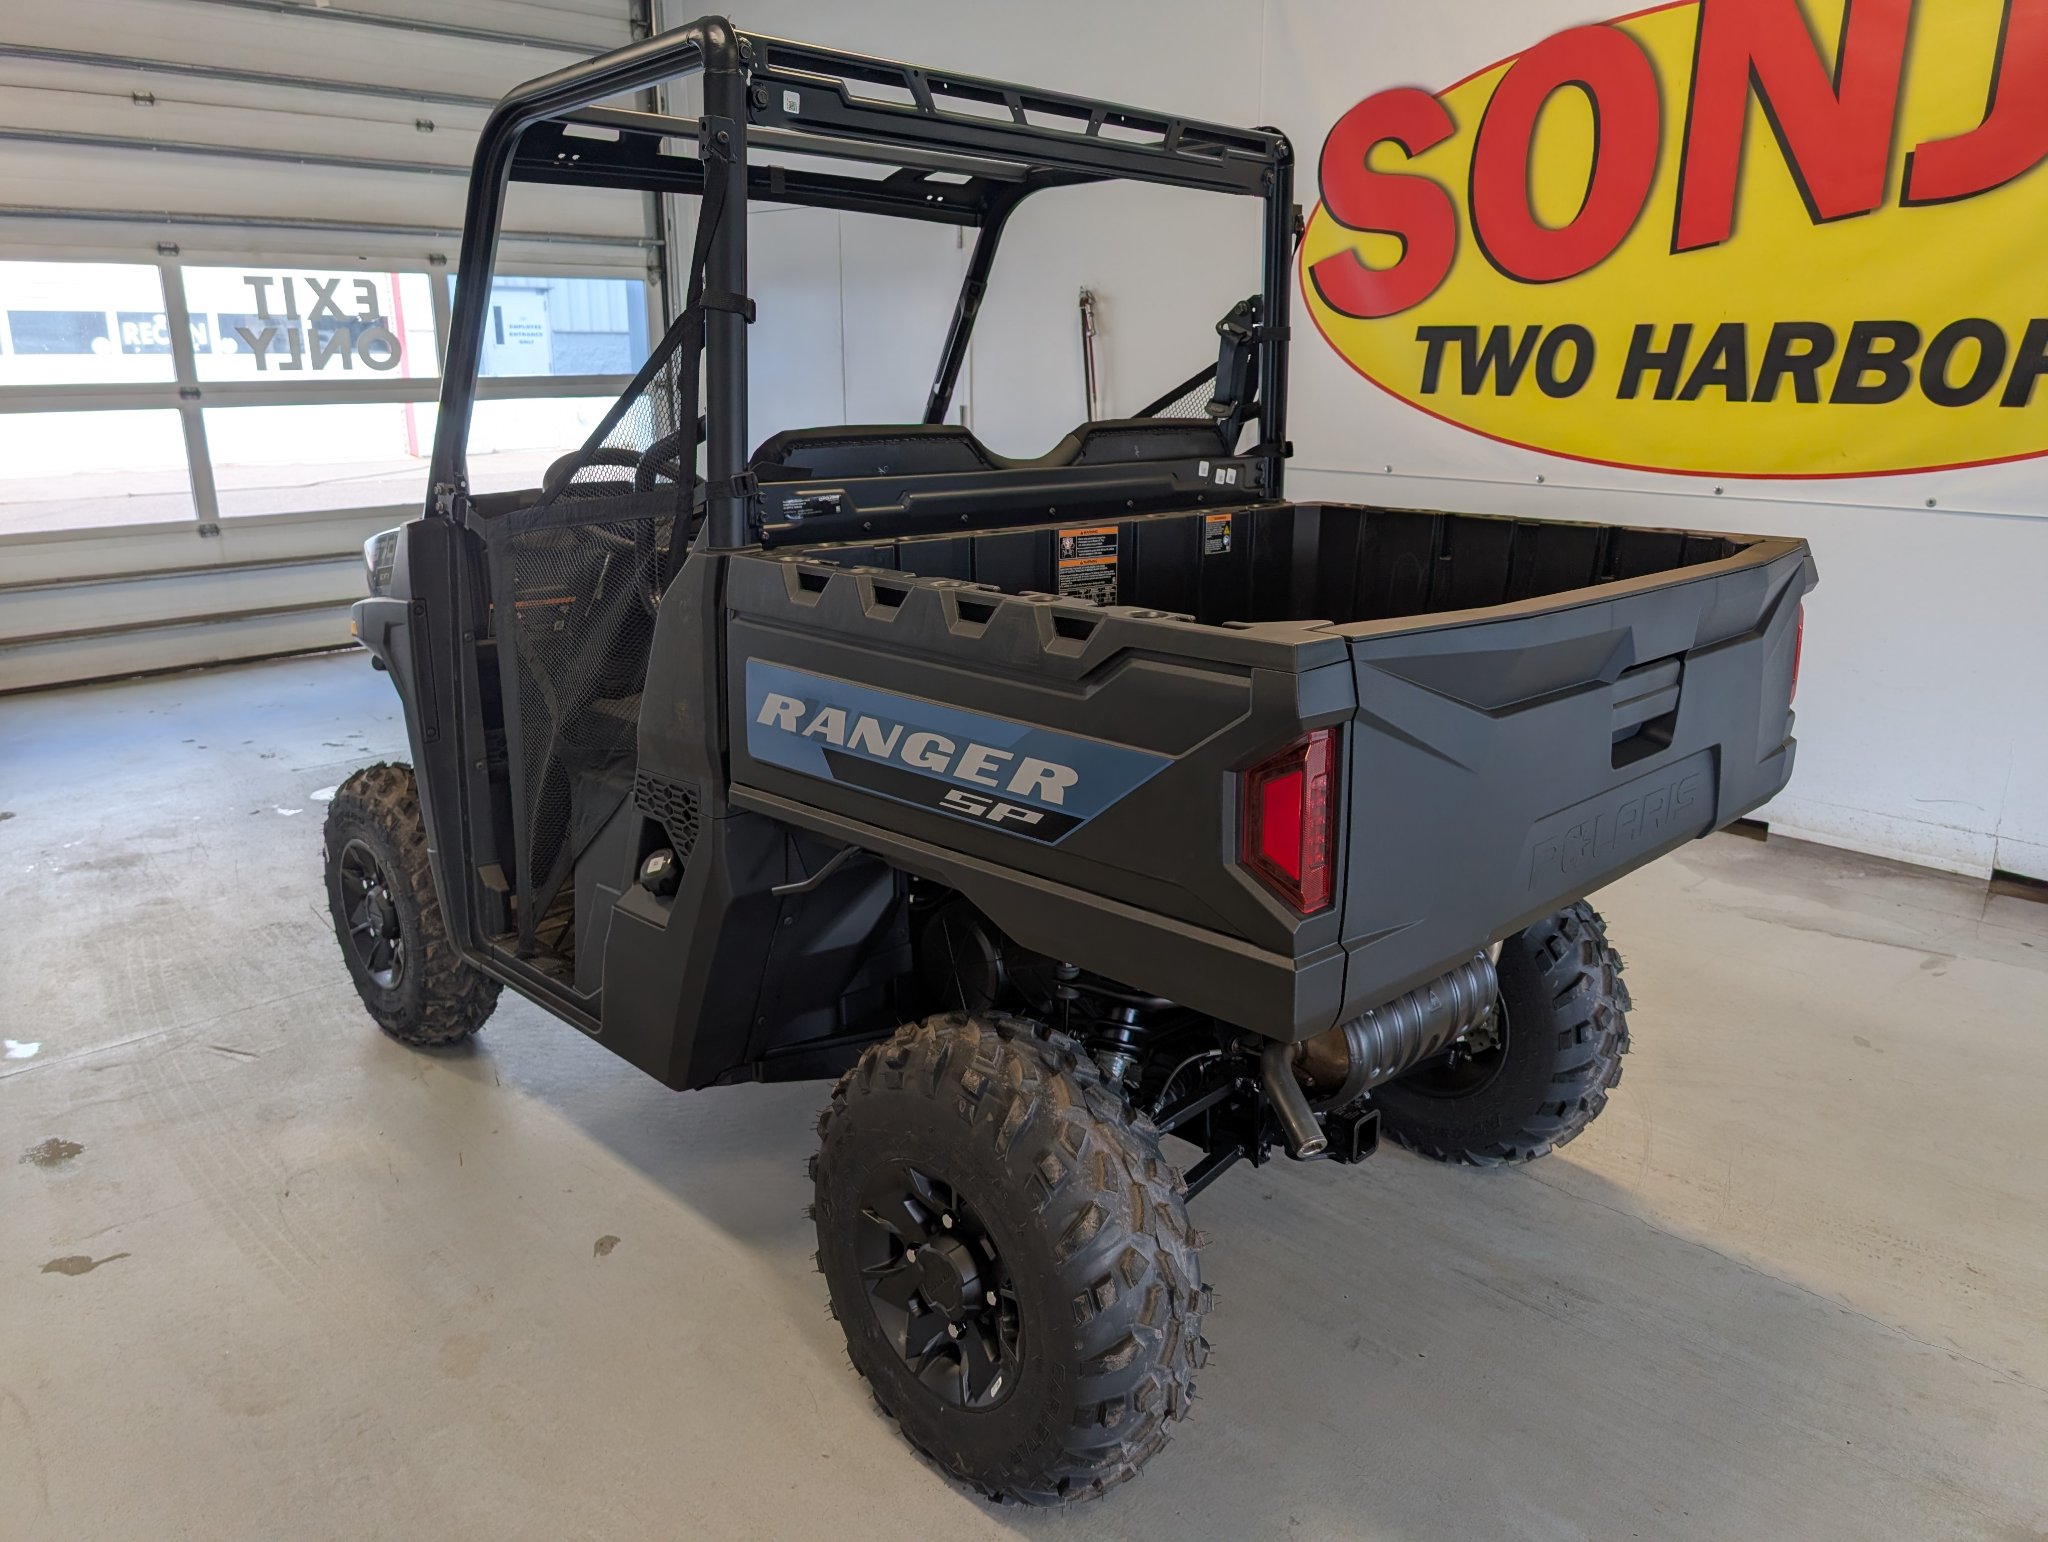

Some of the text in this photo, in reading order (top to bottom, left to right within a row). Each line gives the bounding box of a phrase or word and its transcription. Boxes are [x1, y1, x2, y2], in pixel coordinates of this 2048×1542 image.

[121, 311, 208, 348] RECN
[1415, 324, 1595, 399] TWO
[757, 692, 1079, 805] RANGER
[939, 789, 1045, 825] SP
[1528, 773, 1700, 892] POLARIS
